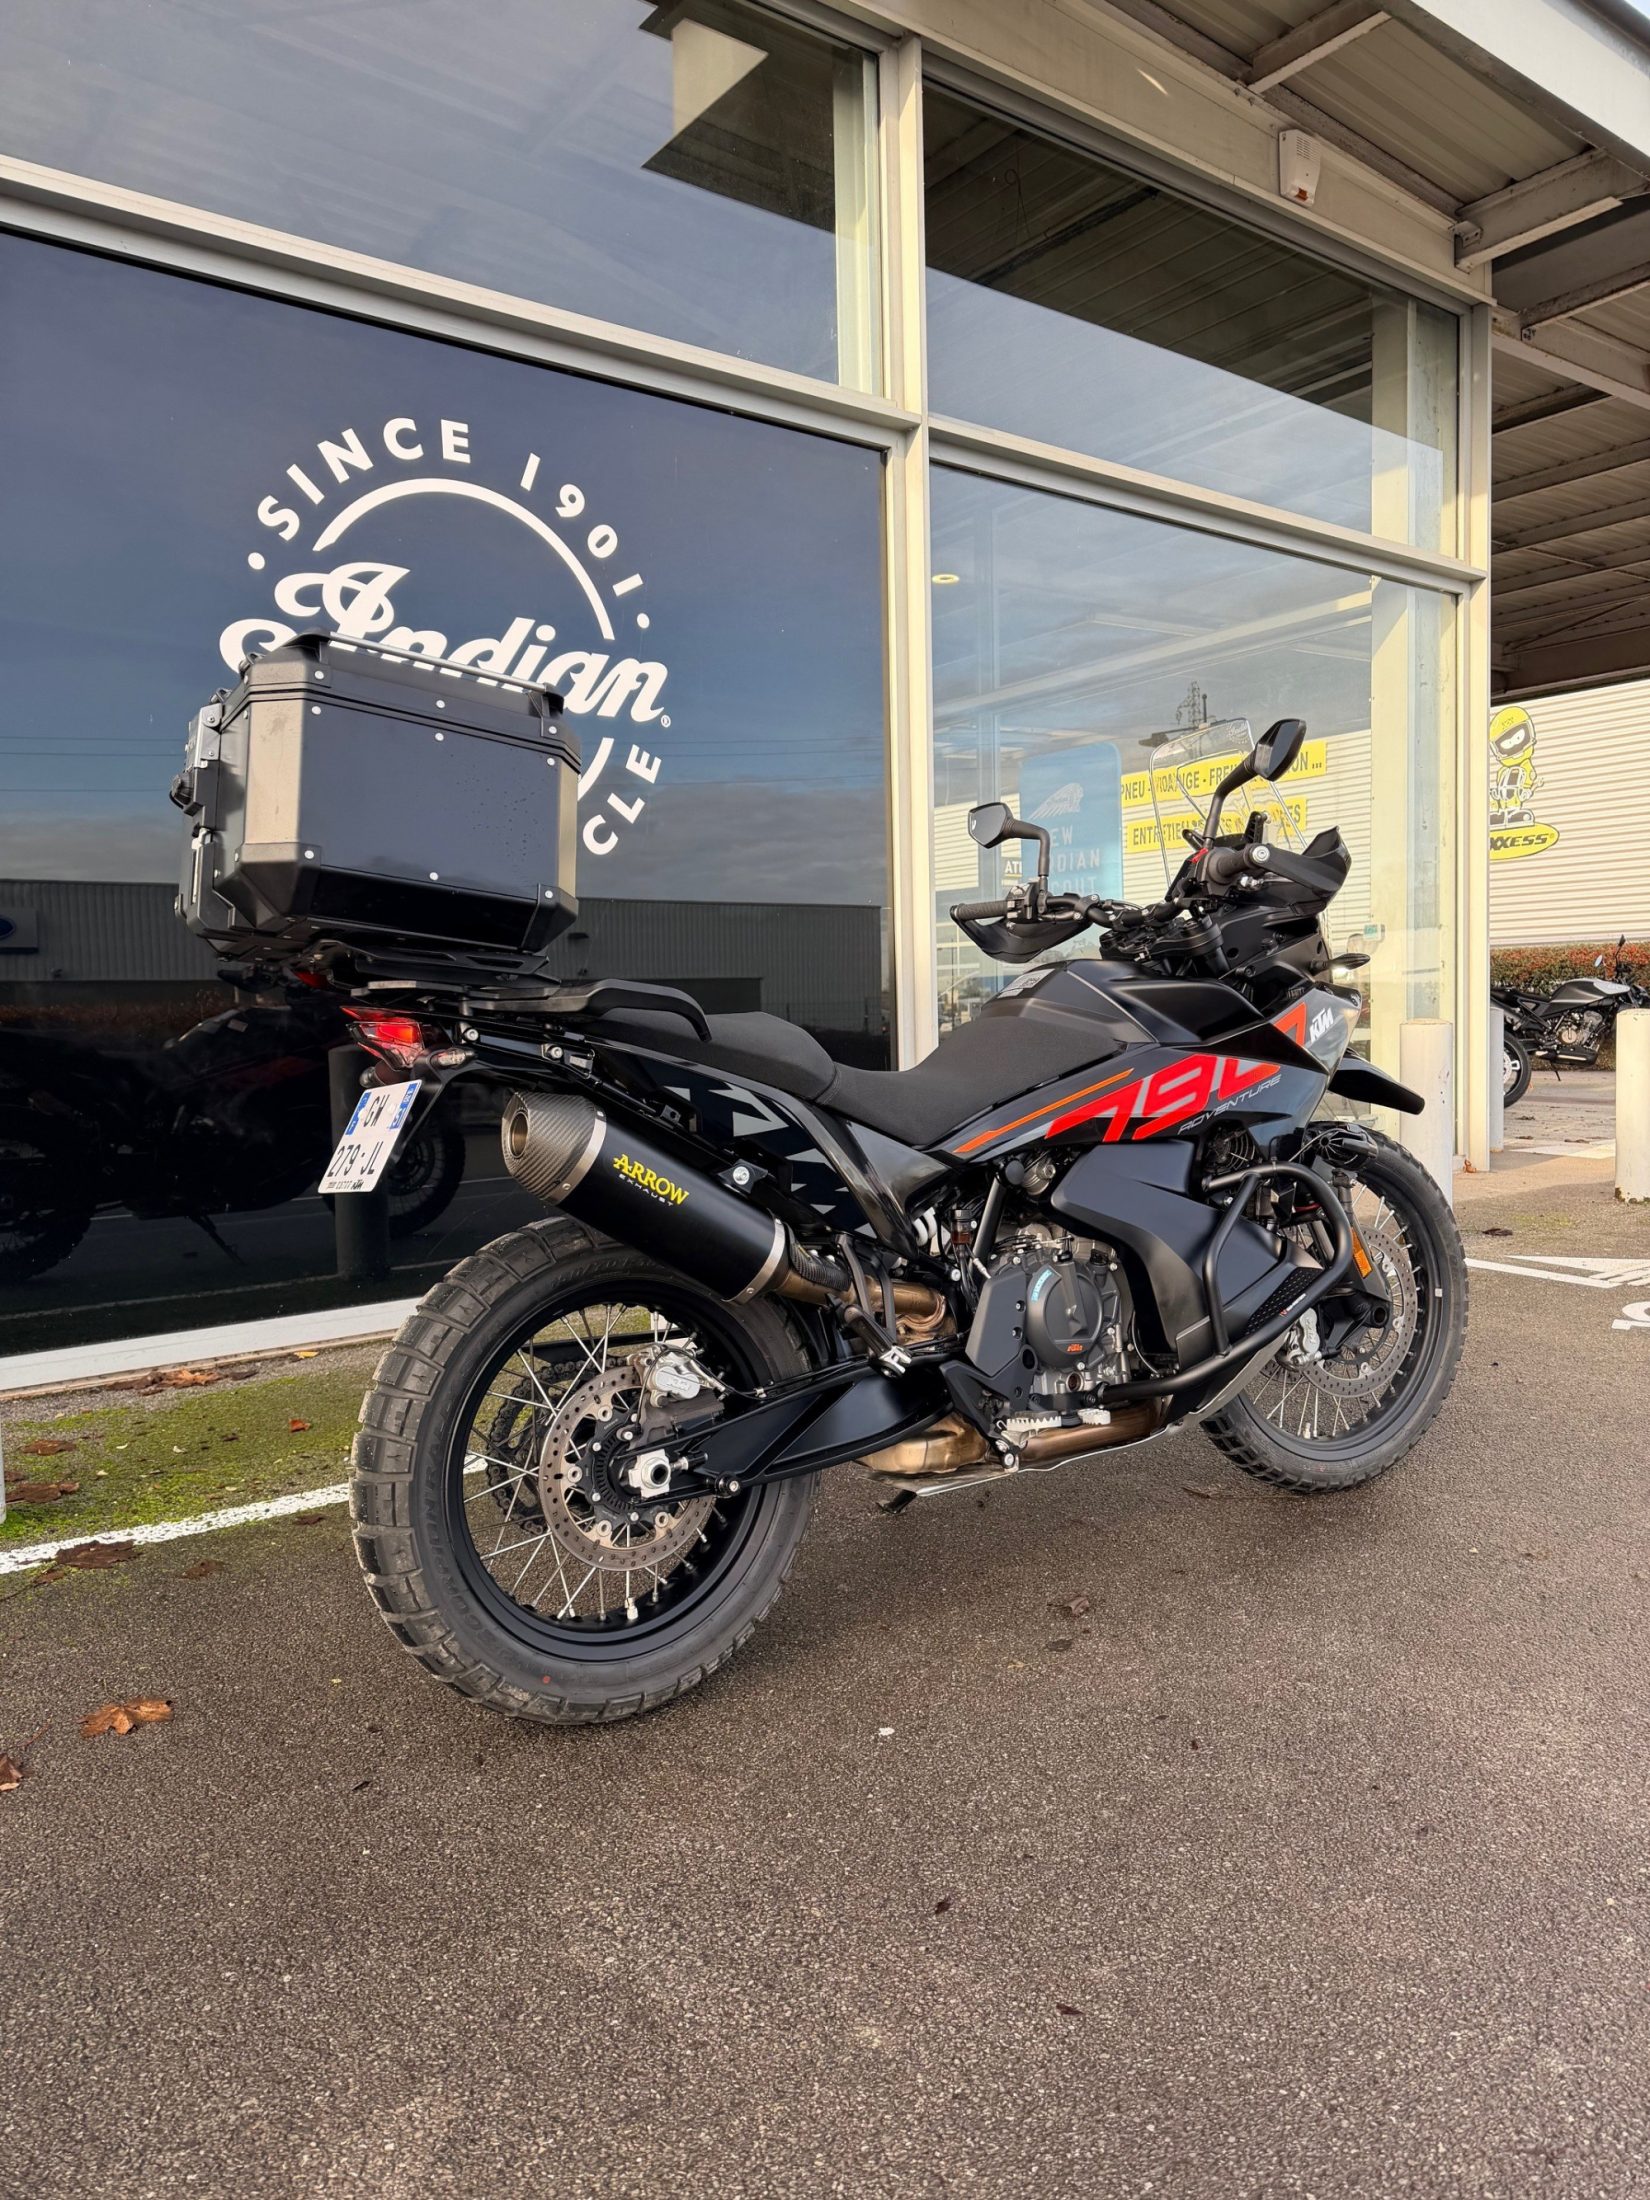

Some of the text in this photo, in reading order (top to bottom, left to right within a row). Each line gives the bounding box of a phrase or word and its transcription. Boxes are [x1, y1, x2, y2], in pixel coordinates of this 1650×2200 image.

[257, 417, 472, 541] SINCE
[218, 561, 670, 723] Indian
[583, 744, 662, 856] CLE
[1309, 1007, 1334, 1044] KTM
[363, 1093, 390, 1127] GW
[1177, 1073, 1282, 1135] ADVENTURE
[613, 1153, 690, 1205] ARROW
